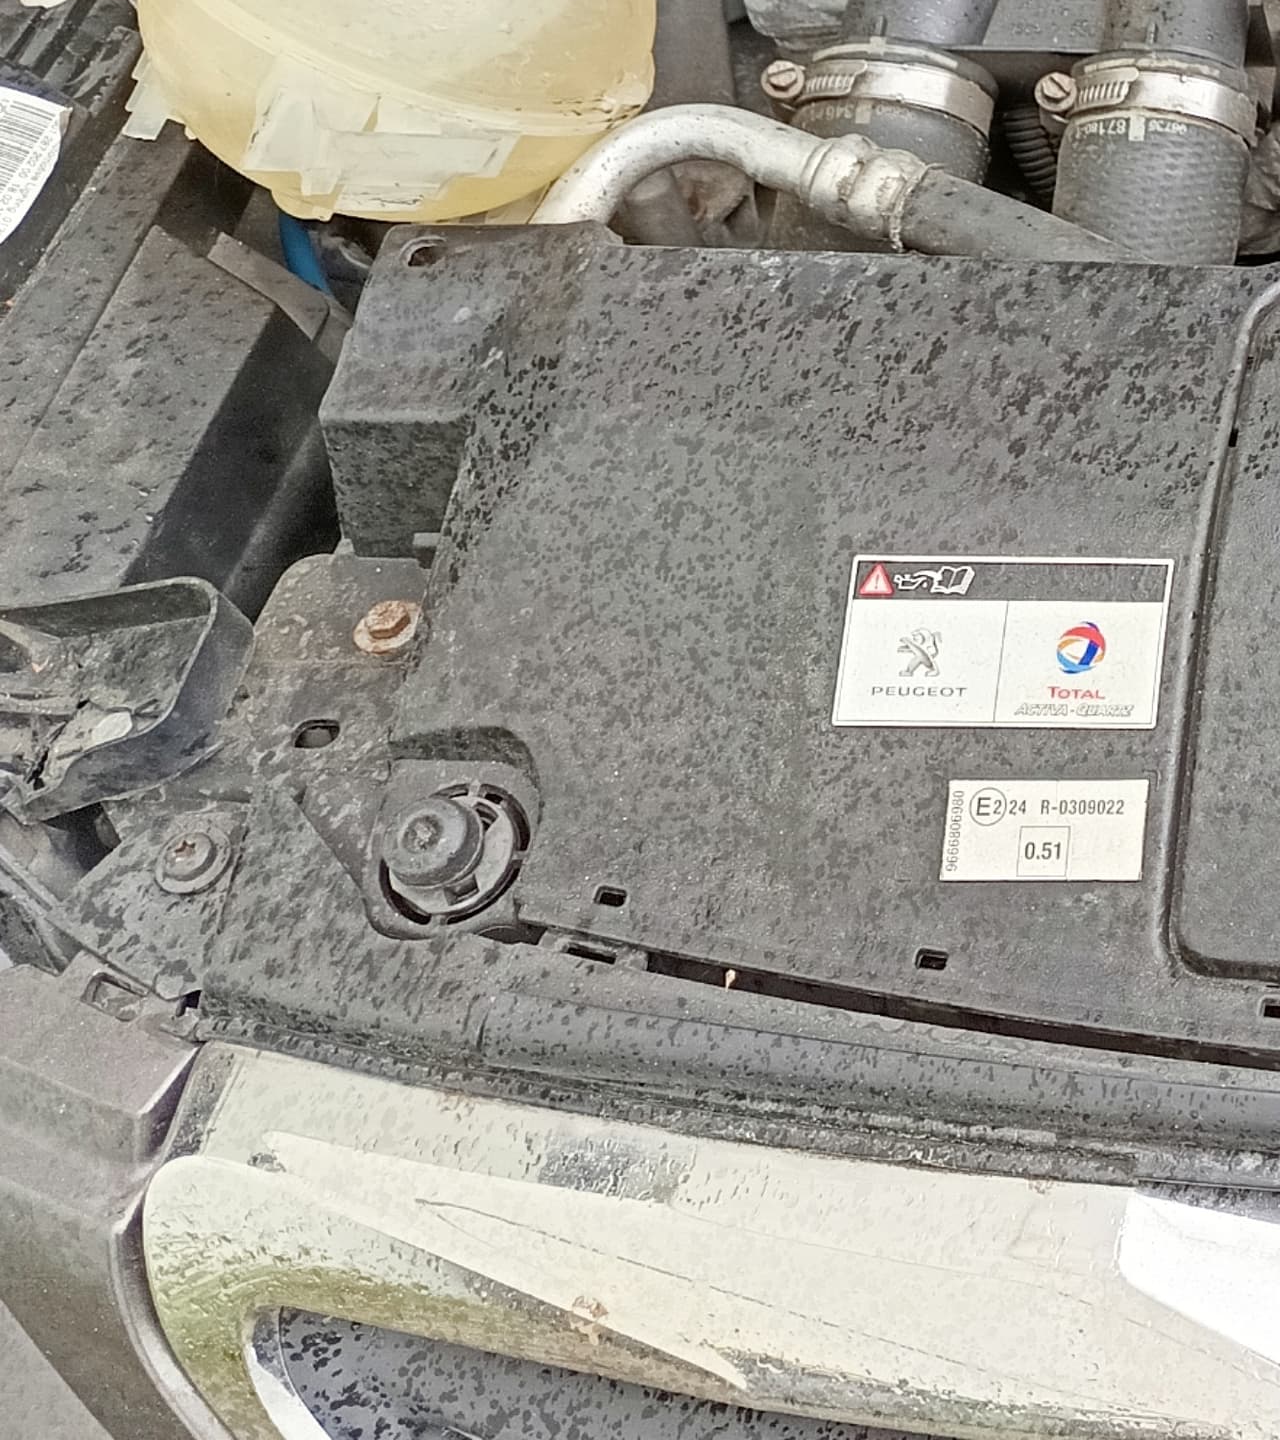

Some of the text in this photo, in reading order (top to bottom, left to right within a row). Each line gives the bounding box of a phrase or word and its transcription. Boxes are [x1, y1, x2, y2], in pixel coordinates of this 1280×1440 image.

[871, 686, 967, 697] PEUGEOT
[1047, 685, 1105, 700] TOTAL
[1009, 799, 1027, 816] 24
[1040, 799, 1125, 815] R-0309022
[1024, 841, 1062, 860] 0.51
